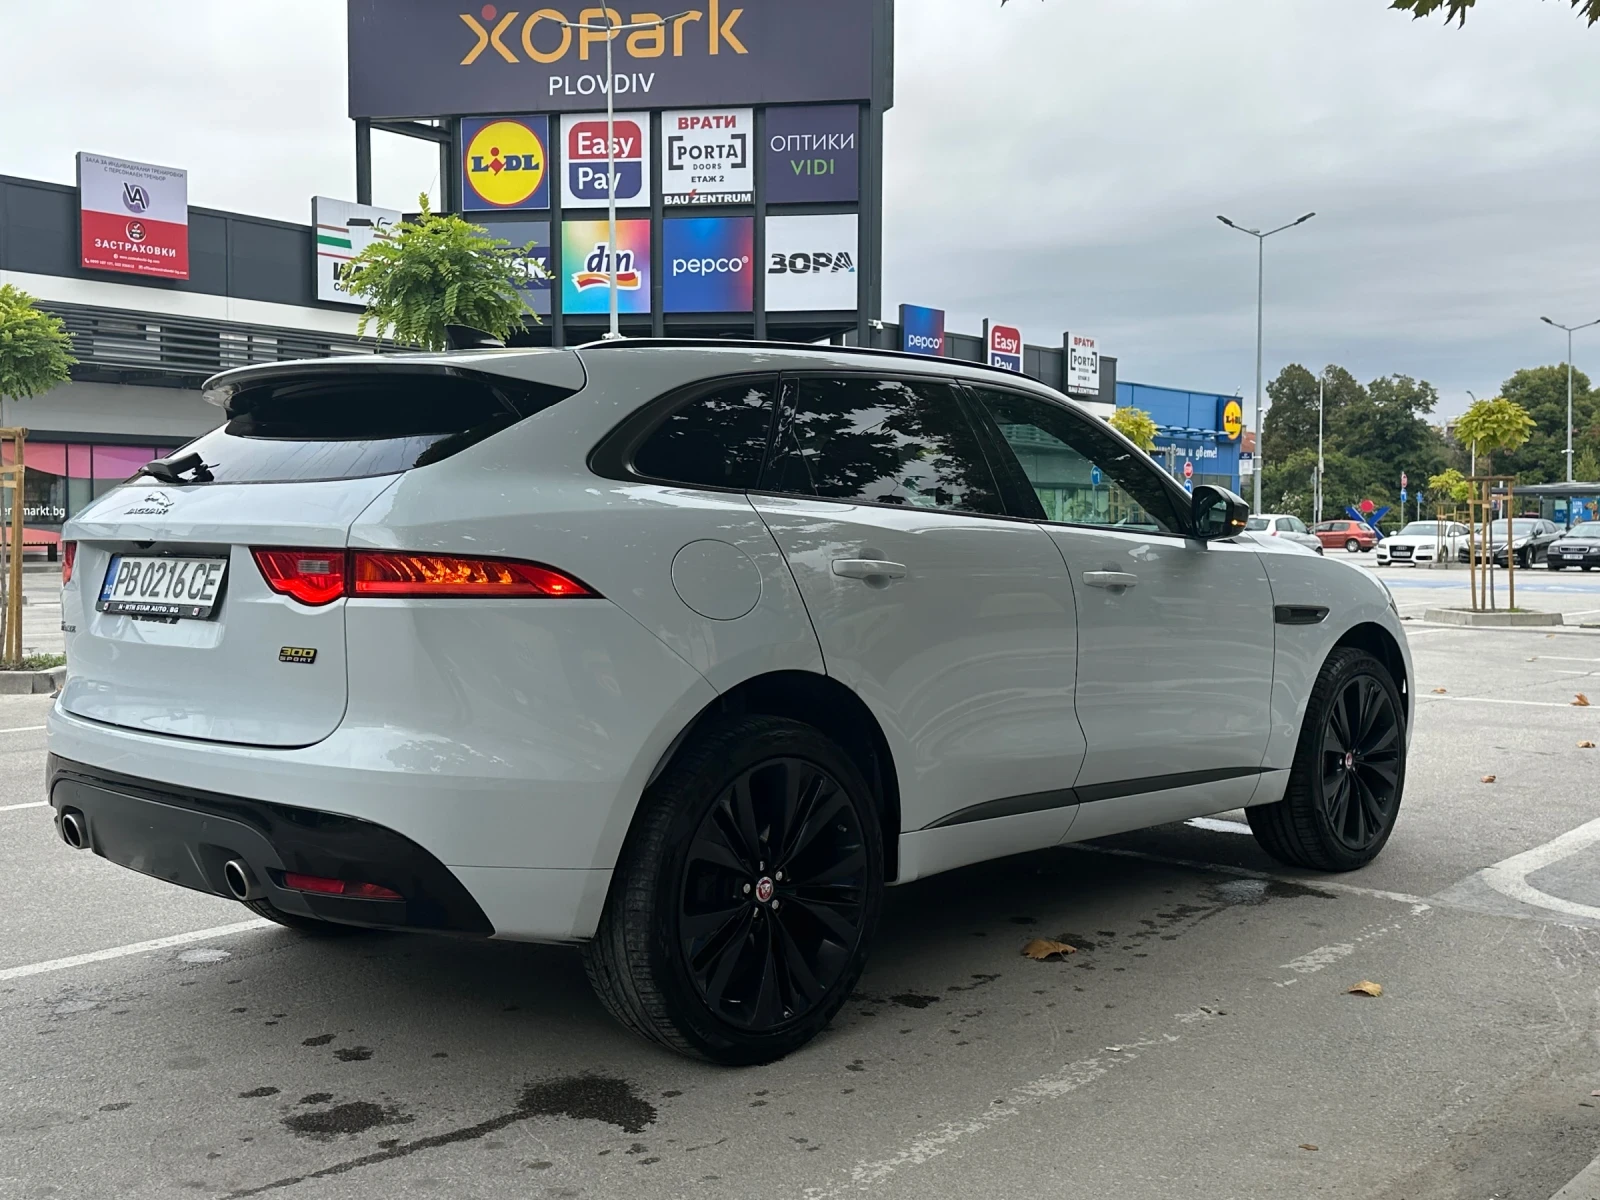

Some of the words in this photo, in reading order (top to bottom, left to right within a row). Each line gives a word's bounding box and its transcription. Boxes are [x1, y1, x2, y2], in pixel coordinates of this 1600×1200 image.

[549, 72, 655, 95] PLOVDIV
[677, 115, 737, 130] ВРАТИ
[577, 132, 634, 158] Easy
[770, 133, 855, 152] ОПТИКИ
[677, 144, 739, 160] PORTA
[692, 163, 722, 171] DOORS
[790, 159, 835, 176] VIDI
[578, 167, 622, 192] Pay
[691, 175, 717, 183] ЕТАЖ
[719, 175, 725, 183] 2
[664, 195, 689, 205] BAU
[691, 193, 751, 204] ZENTRUM
[94, 238, 176, 258] ЗАСТРАХОВКИ
[586, 245, 633, 273] dm
[768, 252, 855, 273] ЗОРА
[994, 332, 1018, 353] Easy
[1073, 336, 1095, 348] ВРАТИ
[1073, 355, 1095, 367] PORTA
[113, 561, 142, 596] PB
[140, 561, 190, 598] 0216
[187, 563, 221, 601] CE
[103, 584, 113, 595] BG
[279, 655, 313, 663] SPORT
[280, 647, 315, 657] 300
